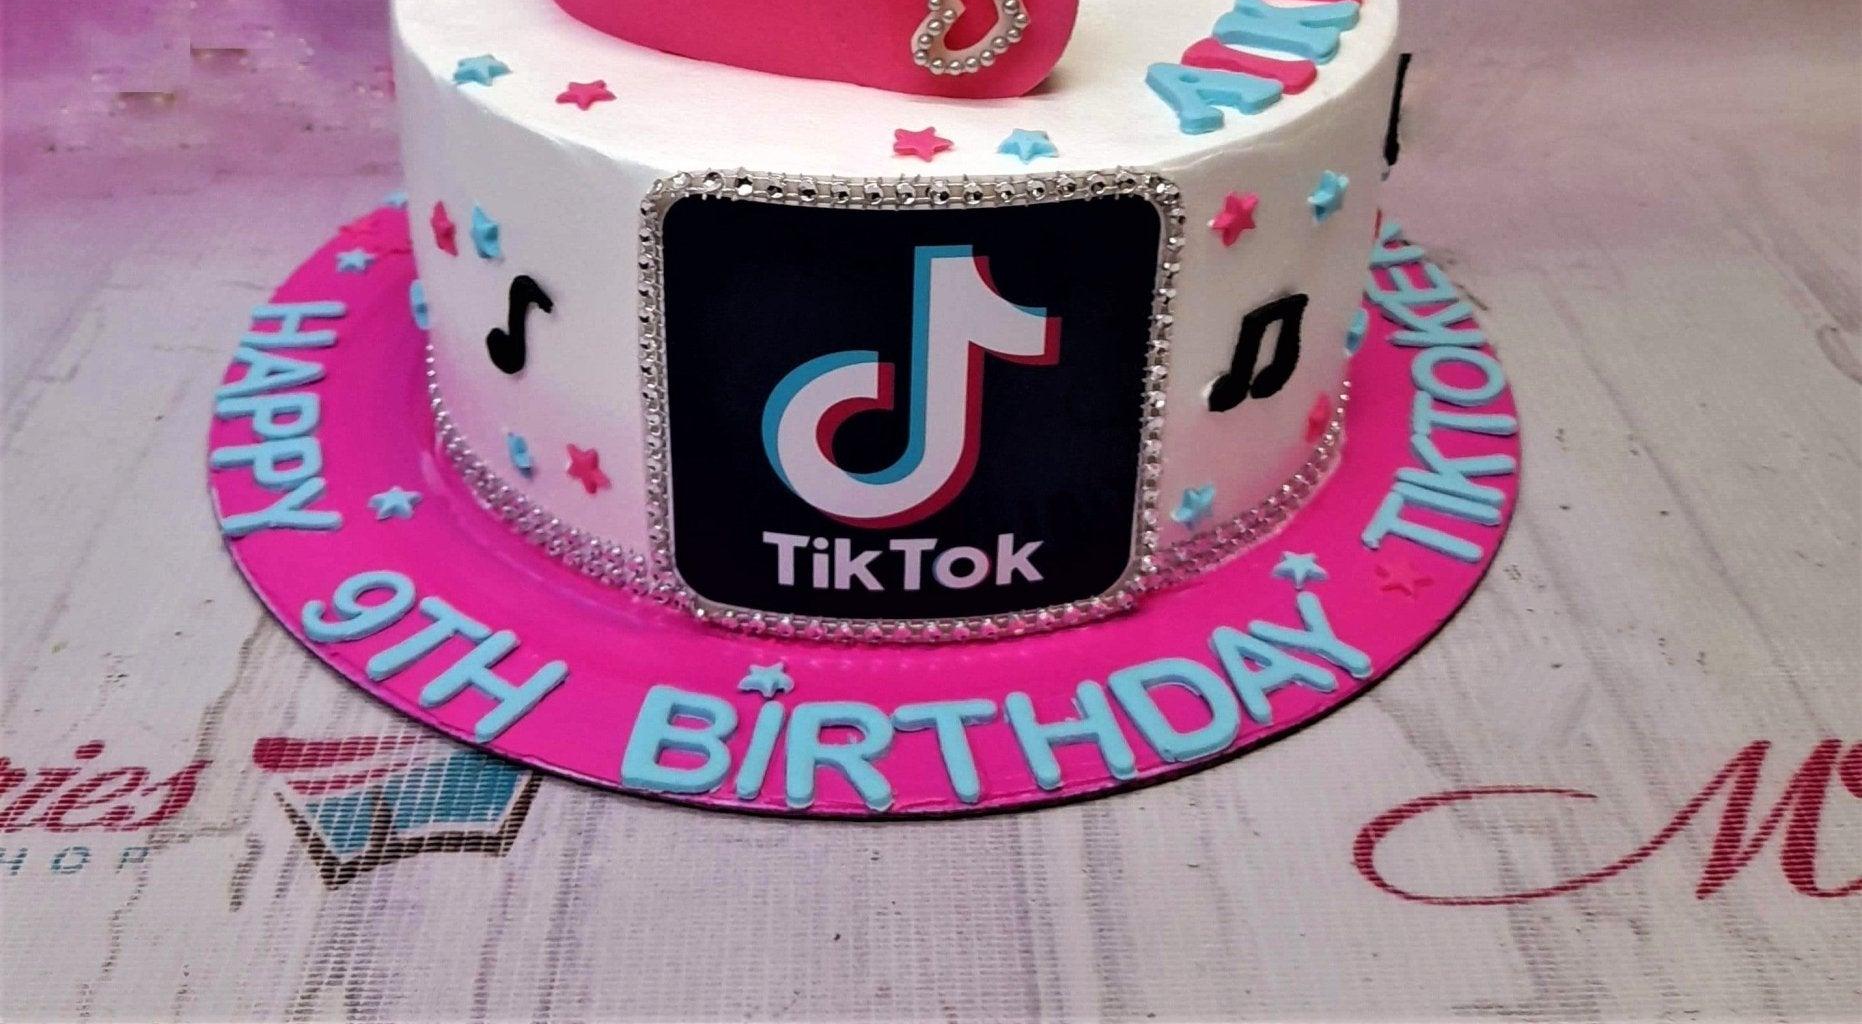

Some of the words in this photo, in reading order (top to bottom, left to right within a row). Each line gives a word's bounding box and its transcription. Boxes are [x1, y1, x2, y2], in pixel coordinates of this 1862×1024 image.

[210, 301, 347, 539] HAPPY
[301, 569, 571, 744] 9TH
[620, 589, 1372, 811] BIRTHDAY
[1361, 219, 1519, 564] TIKTOKER
[762, 530, 1045, 592] TikTok
